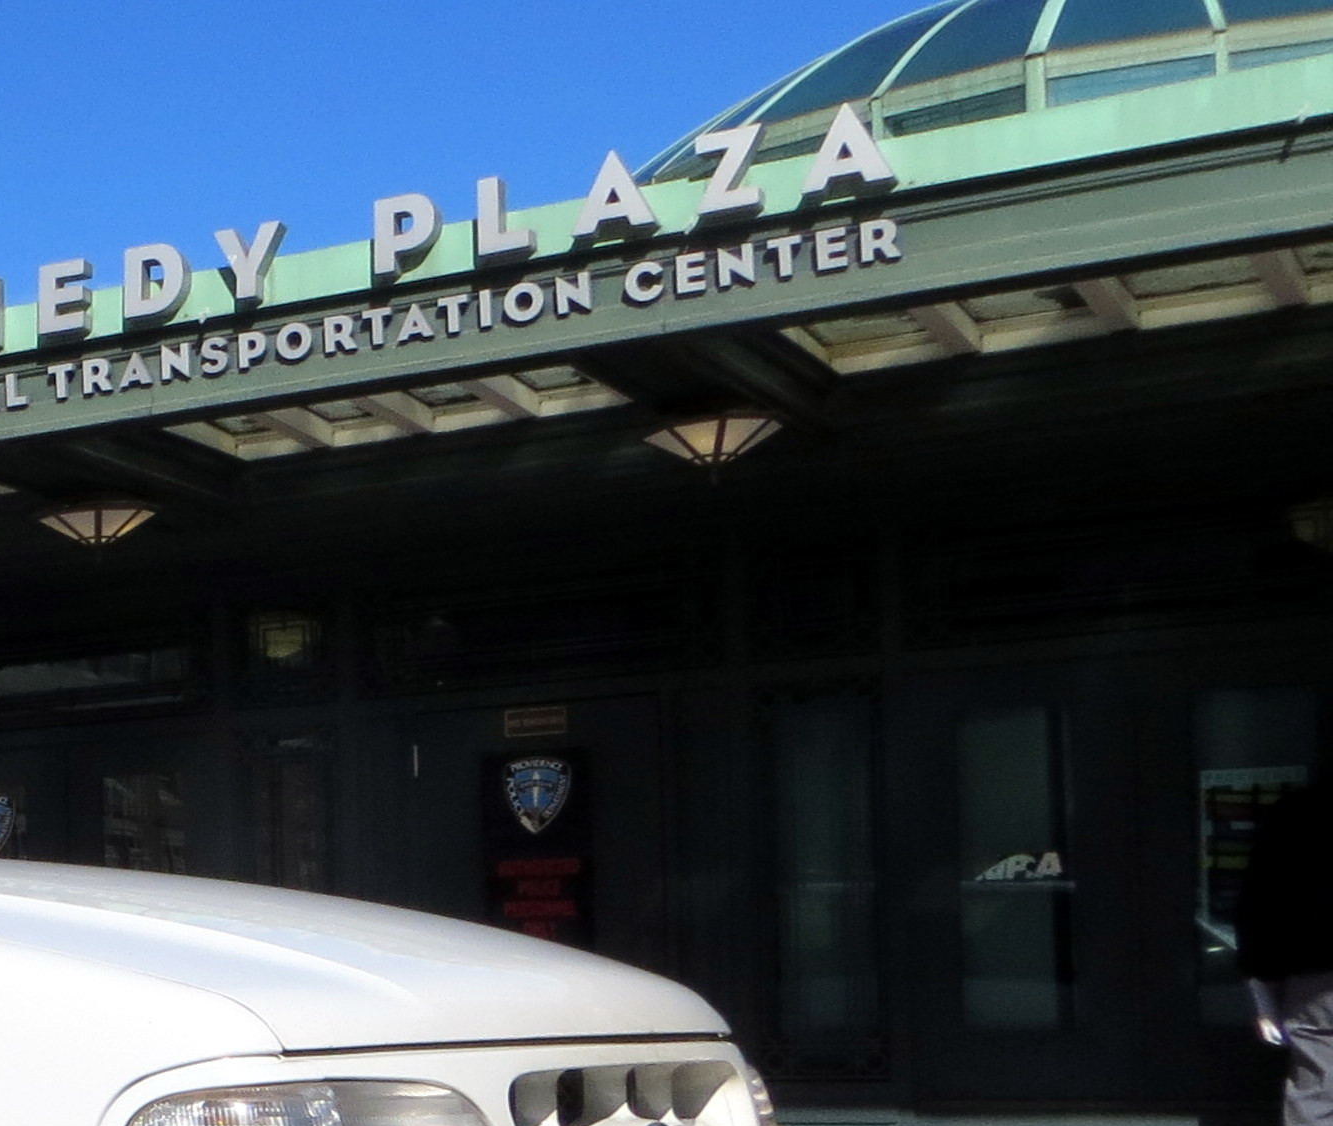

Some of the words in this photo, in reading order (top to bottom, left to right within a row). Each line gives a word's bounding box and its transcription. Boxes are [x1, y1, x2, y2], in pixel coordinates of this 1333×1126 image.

[373, 102, 899, 286] PLAZA
[48, 271, 593, 399] TRANSPORTATION
[625, 219, 901, 304] CENTER
